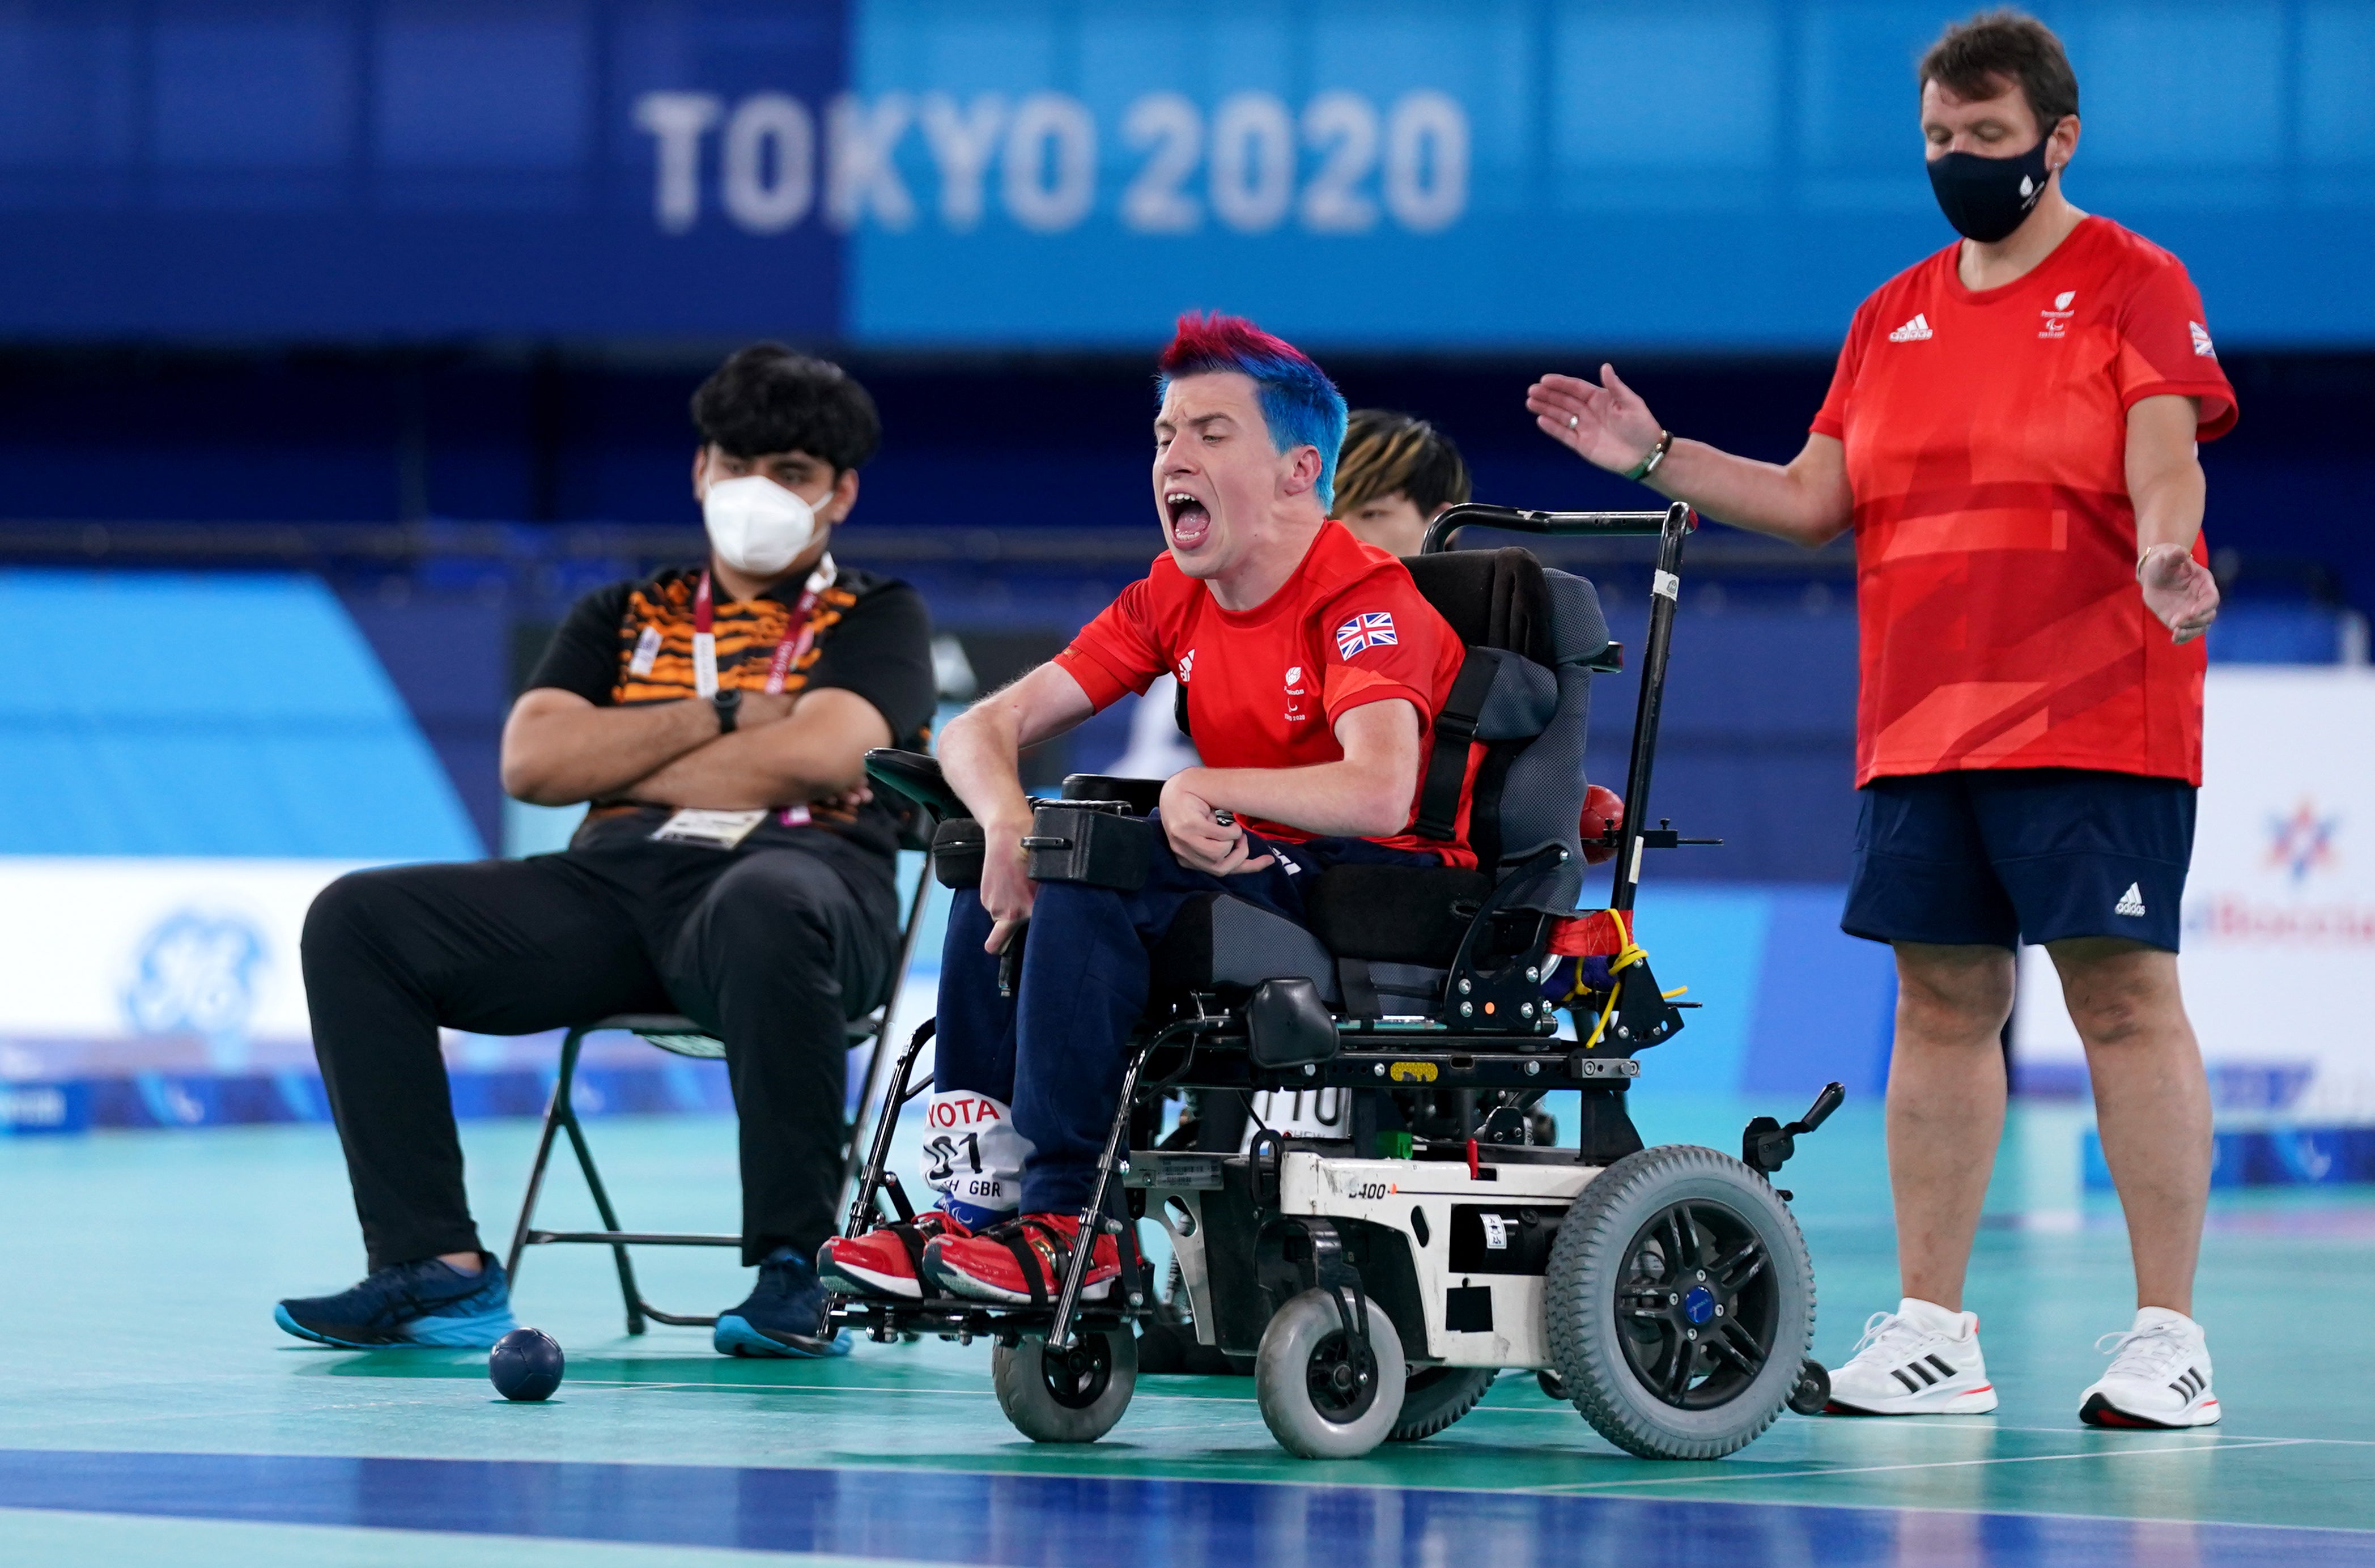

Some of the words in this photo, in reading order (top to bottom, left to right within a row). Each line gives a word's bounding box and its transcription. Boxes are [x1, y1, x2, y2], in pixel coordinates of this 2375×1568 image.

[637, 90, 1099, 233] TOKYO
[1122, 90, 1471, 233] 2020
[1889, 329, 1933, 342] adidas
[2114, 903, 2146, 917] adidas
[970, 1180, 1002, 1197] GBR
